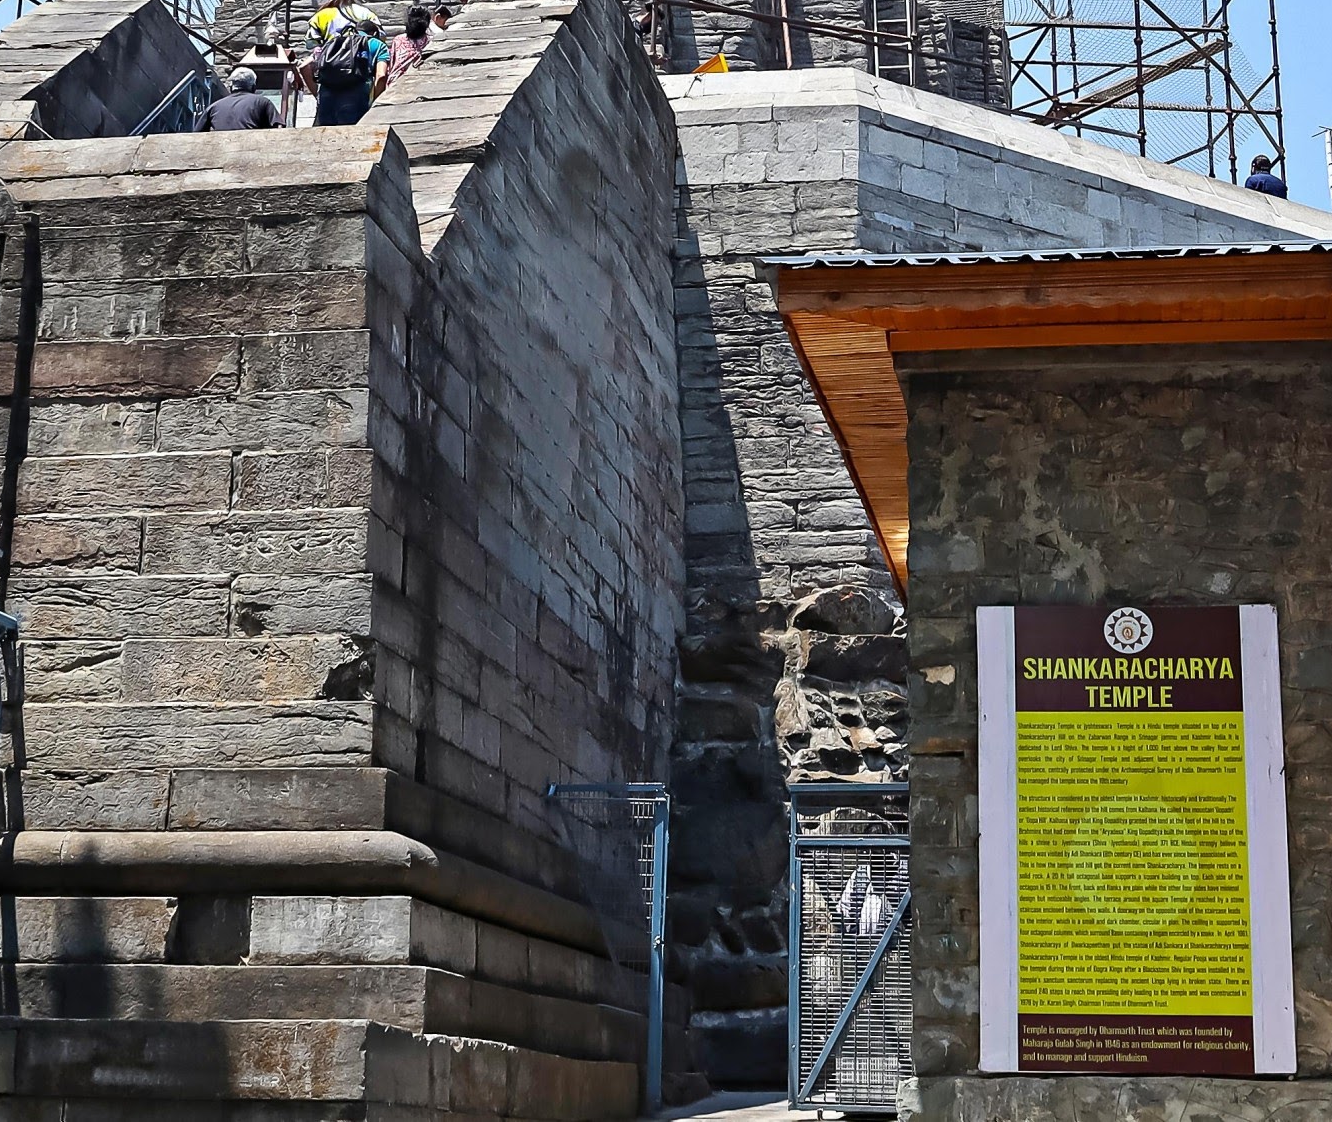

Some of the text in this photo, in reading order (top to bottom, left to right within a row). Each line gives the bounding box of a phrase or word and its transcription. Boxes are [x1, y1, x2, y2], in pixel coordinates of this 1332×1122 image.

[1023, 657, 1234, 680] SHANKARACHARYA
[1085, 685, 1173, 708] TEMPLE
[1023, 1025, 1232, 1038] Temple is managed by Dharmarth Trust which was founded by
[1023, 1038, 1053, 1050] Maharaja
[1055, 1039, 1073, 1048] Gulab
[1076, 1039, 1094, 1050] Singh
[1096, 1039, 1102, 1049] in
[1105, 1039, 1120, 1049] 1846
[1121, 1041, 1129, 1049] as
[1131, 1041, 1139, 1049] an
[1141, 1040, 1180, 1049] endowment
[1183, 1040, 1191, 1050] for
[1194, 1041, 1223, 1052] religious
[1023, 1051, 1035, 1061] and
[1037, 1051, 1044, 1061] to
[1045, 1053, 1072, 1063] manage
[1074, 1052, 1086, 1061] and
[1088, 1052, 1113, 1064] support
